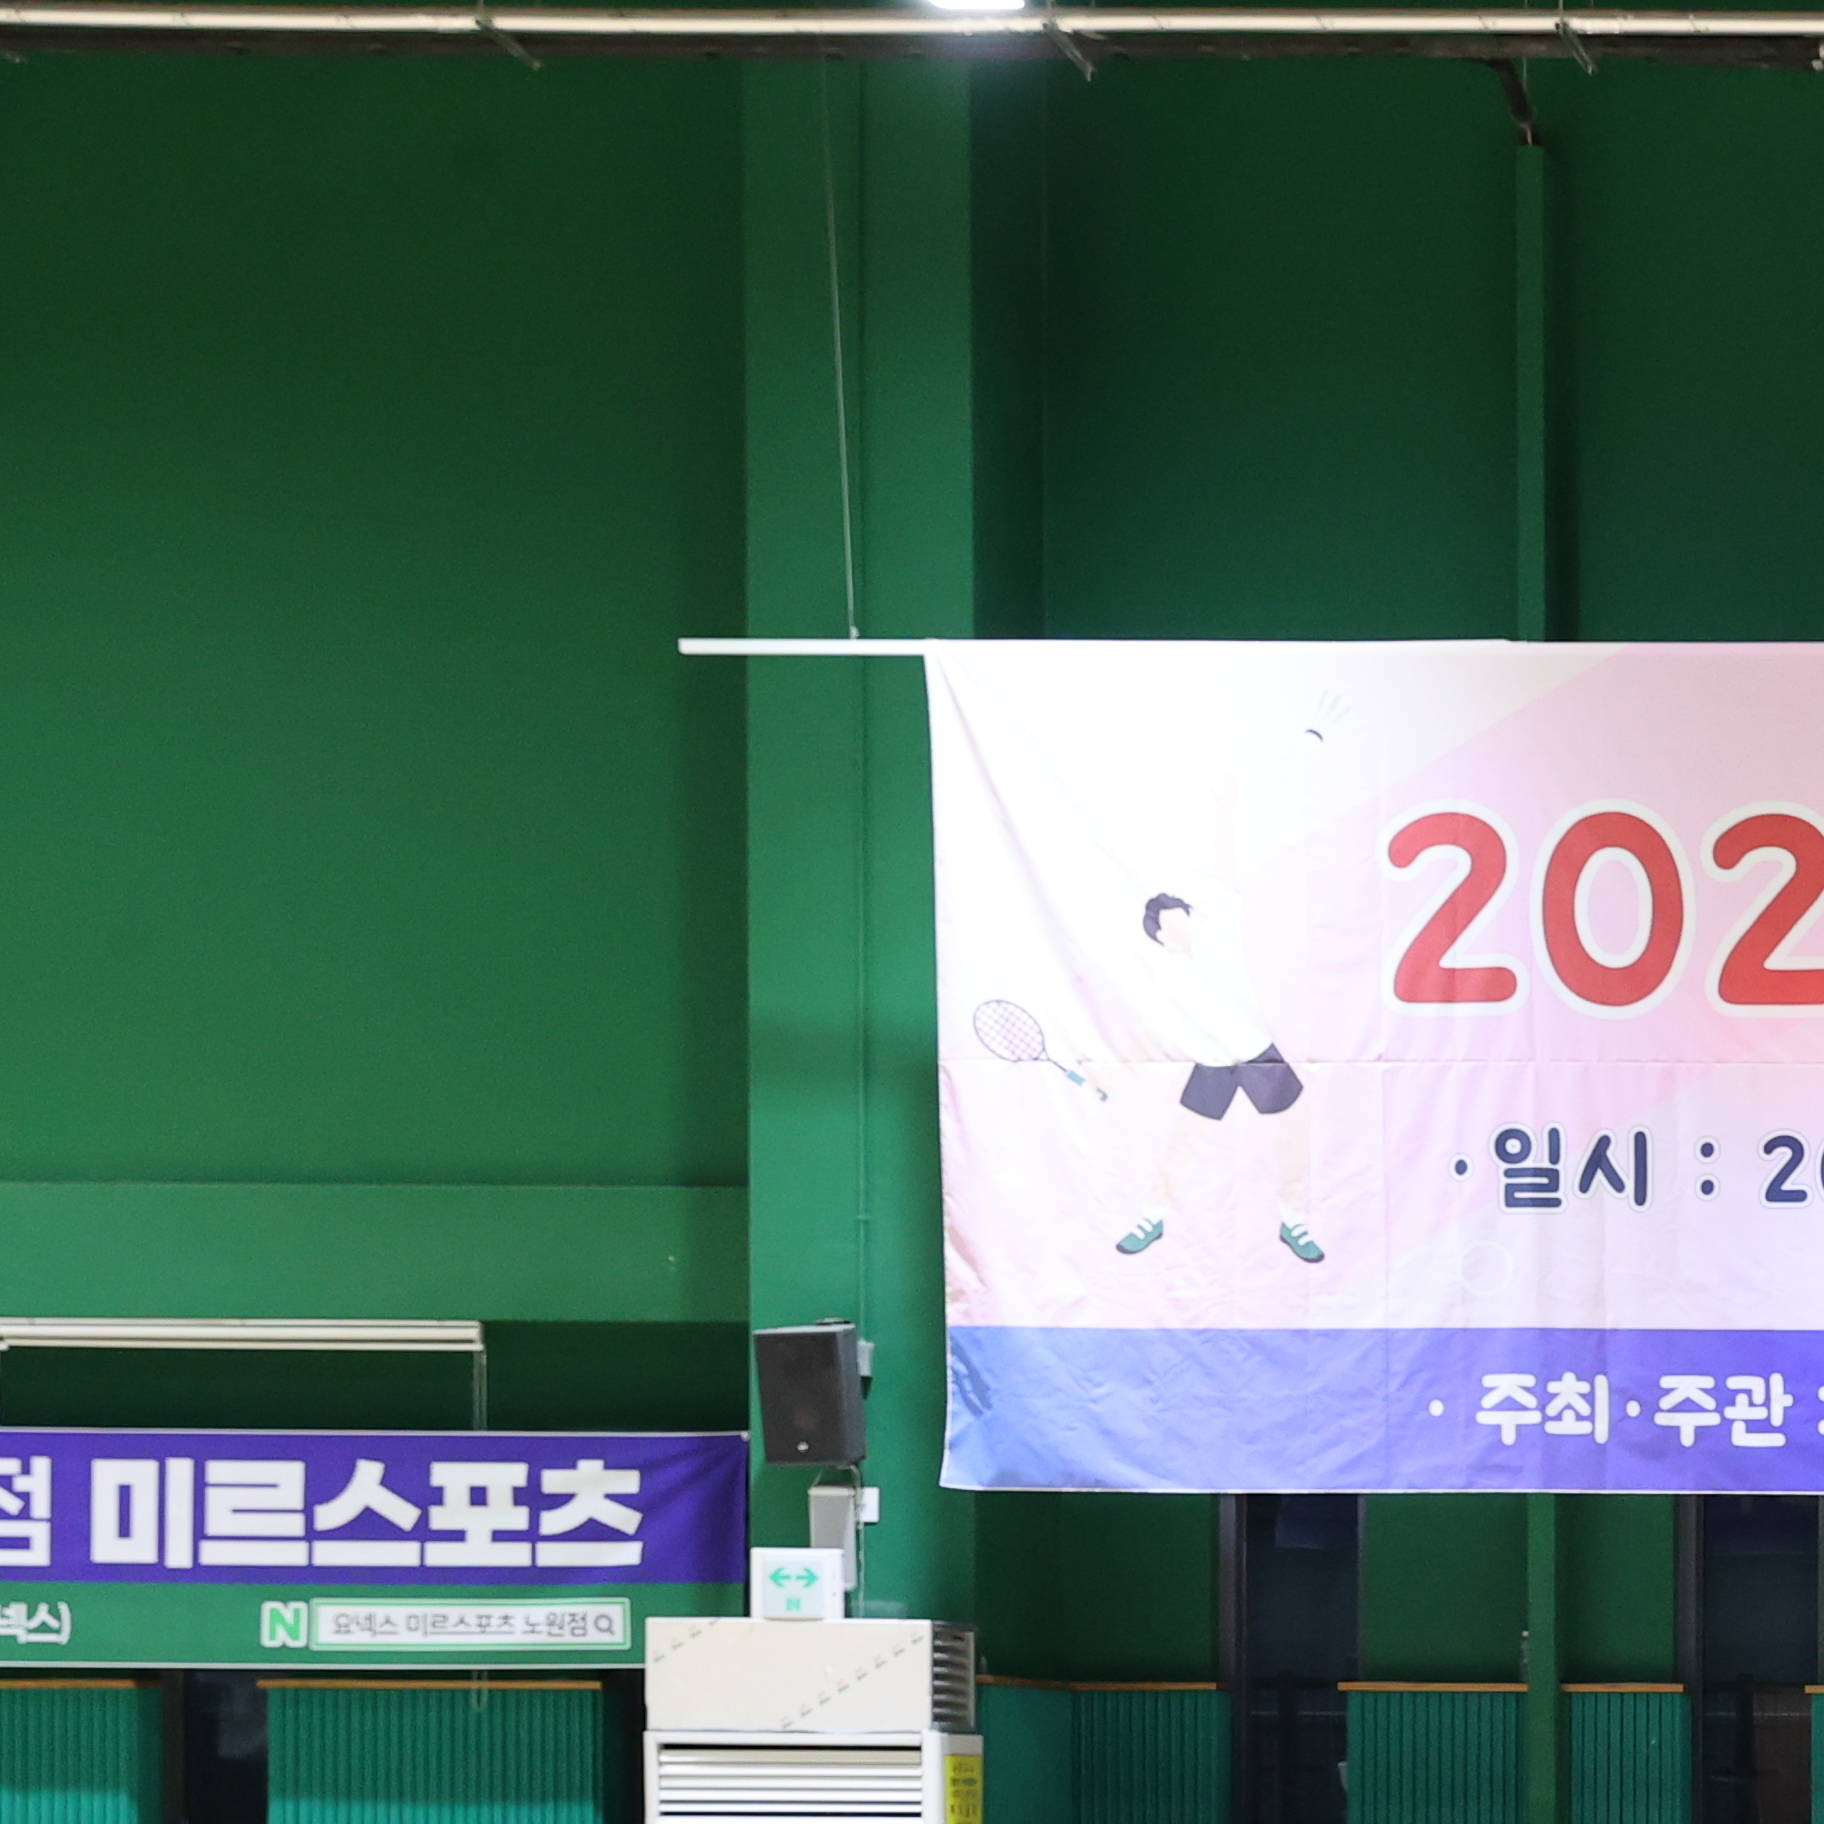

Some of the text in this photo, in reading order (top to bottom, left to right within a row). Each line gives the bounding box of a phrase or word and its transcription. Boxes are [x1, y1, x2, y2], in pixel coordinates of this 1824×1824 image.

[90, 1457, 644, 1569] 미르스포츠
[333, 1611, 588, 1637] 요넥스 미르스포츠 노원점
